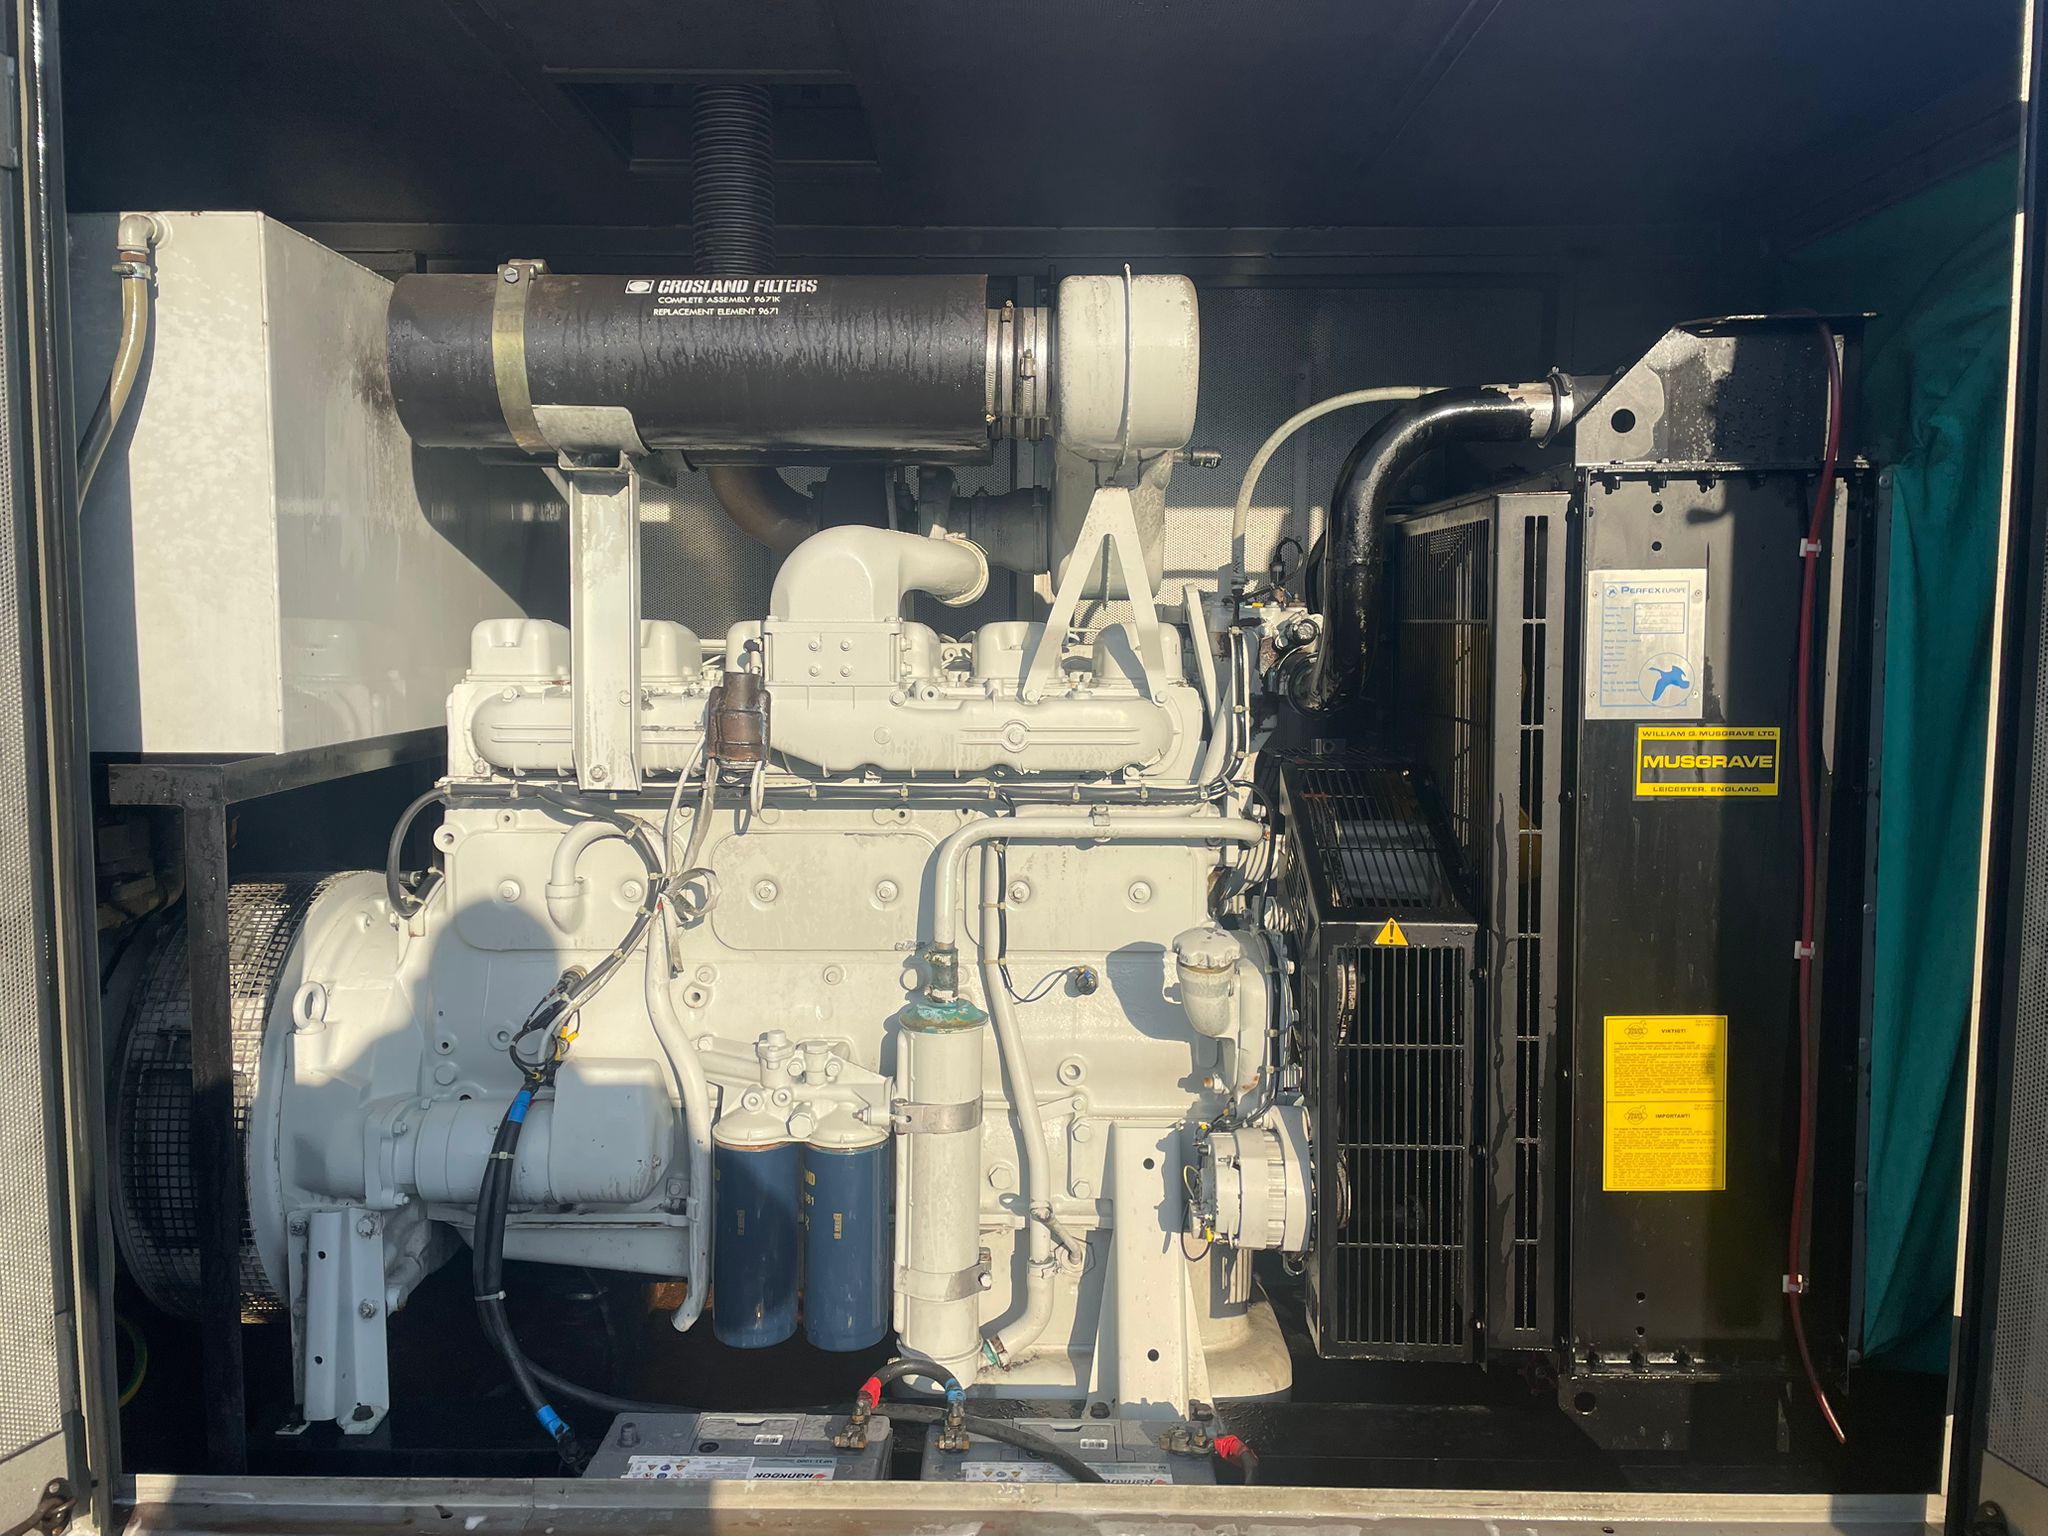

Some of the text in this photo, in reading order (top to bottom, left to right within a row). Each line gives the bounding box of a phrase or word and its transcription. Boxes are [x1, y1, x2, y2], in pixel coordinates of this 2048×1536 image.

[657, 279, 819, 294] CROSLAND FILTERS
[657, 295, 781, 304] COMPLETE ASSEMBLY 9671K
[653, 307, 779, 316] REPLACEMENT ELEMENT 9671
[1643, 755, 1773, 768] MUSGRAVE
